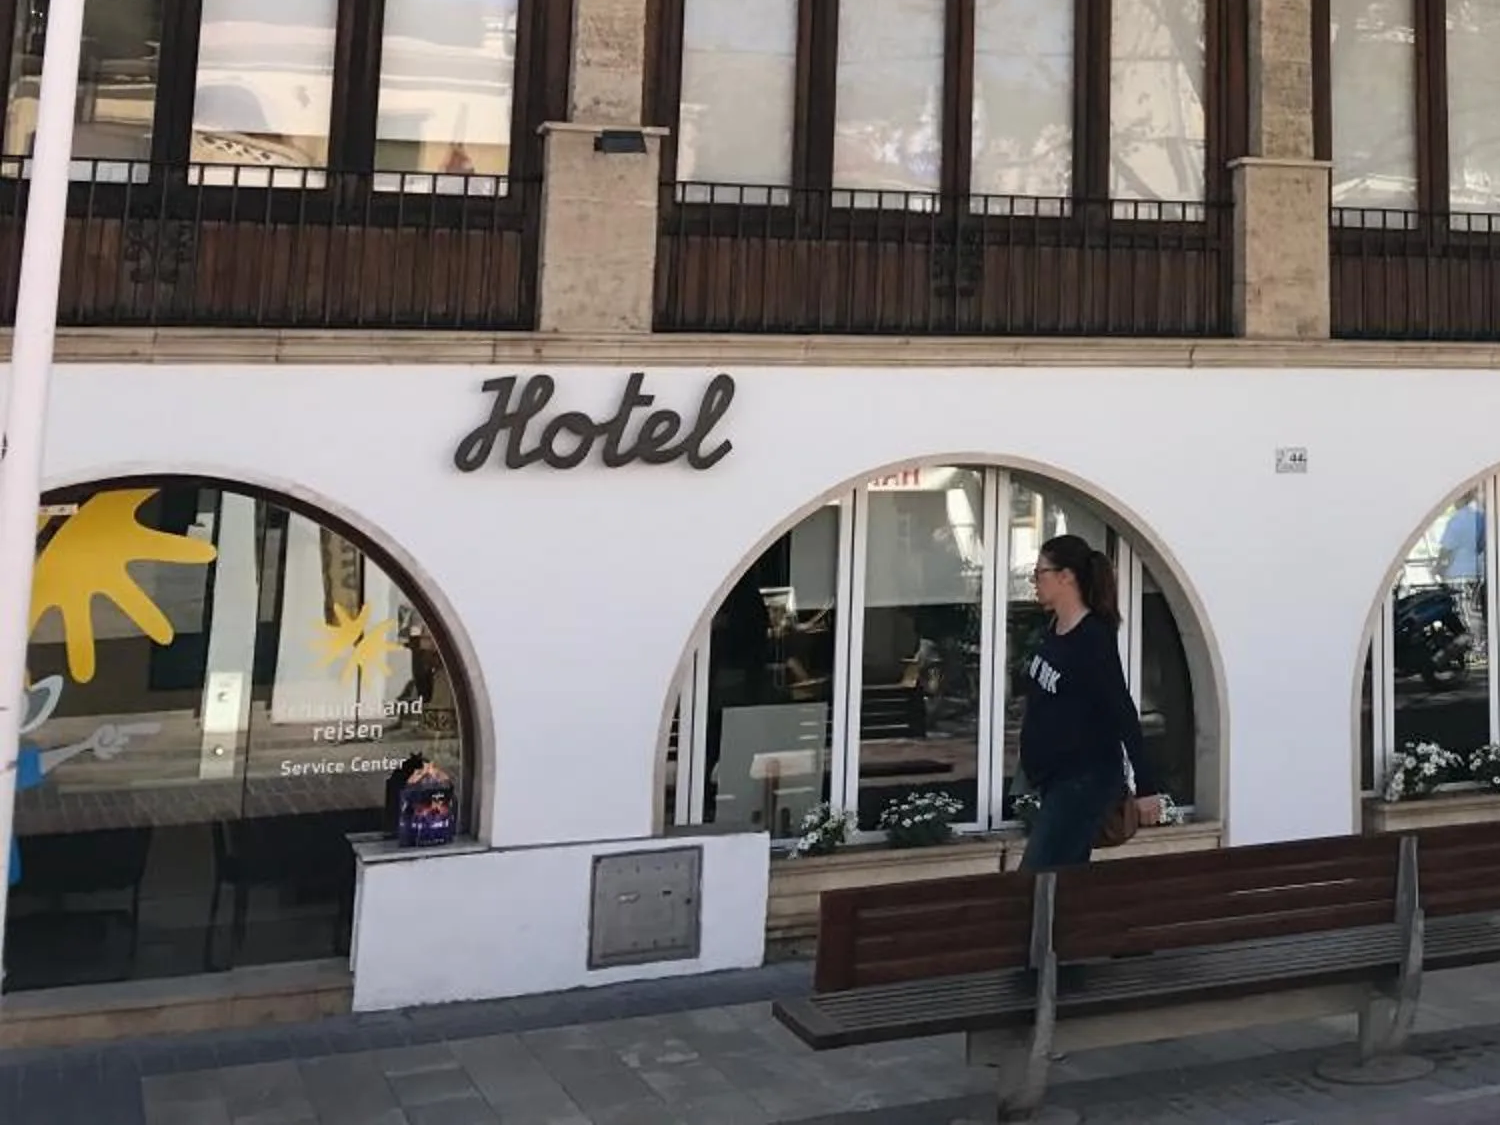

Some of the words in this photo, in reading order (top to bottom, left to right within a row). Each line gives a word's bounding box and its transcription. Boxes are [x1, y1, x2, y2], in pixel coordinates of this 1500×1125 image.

[454, 372, 735, 472] Hotel
[312, 719, 383, 742] reisen
[280, 759, 345, 776] Service
[351, 756, 407, 773] Center
